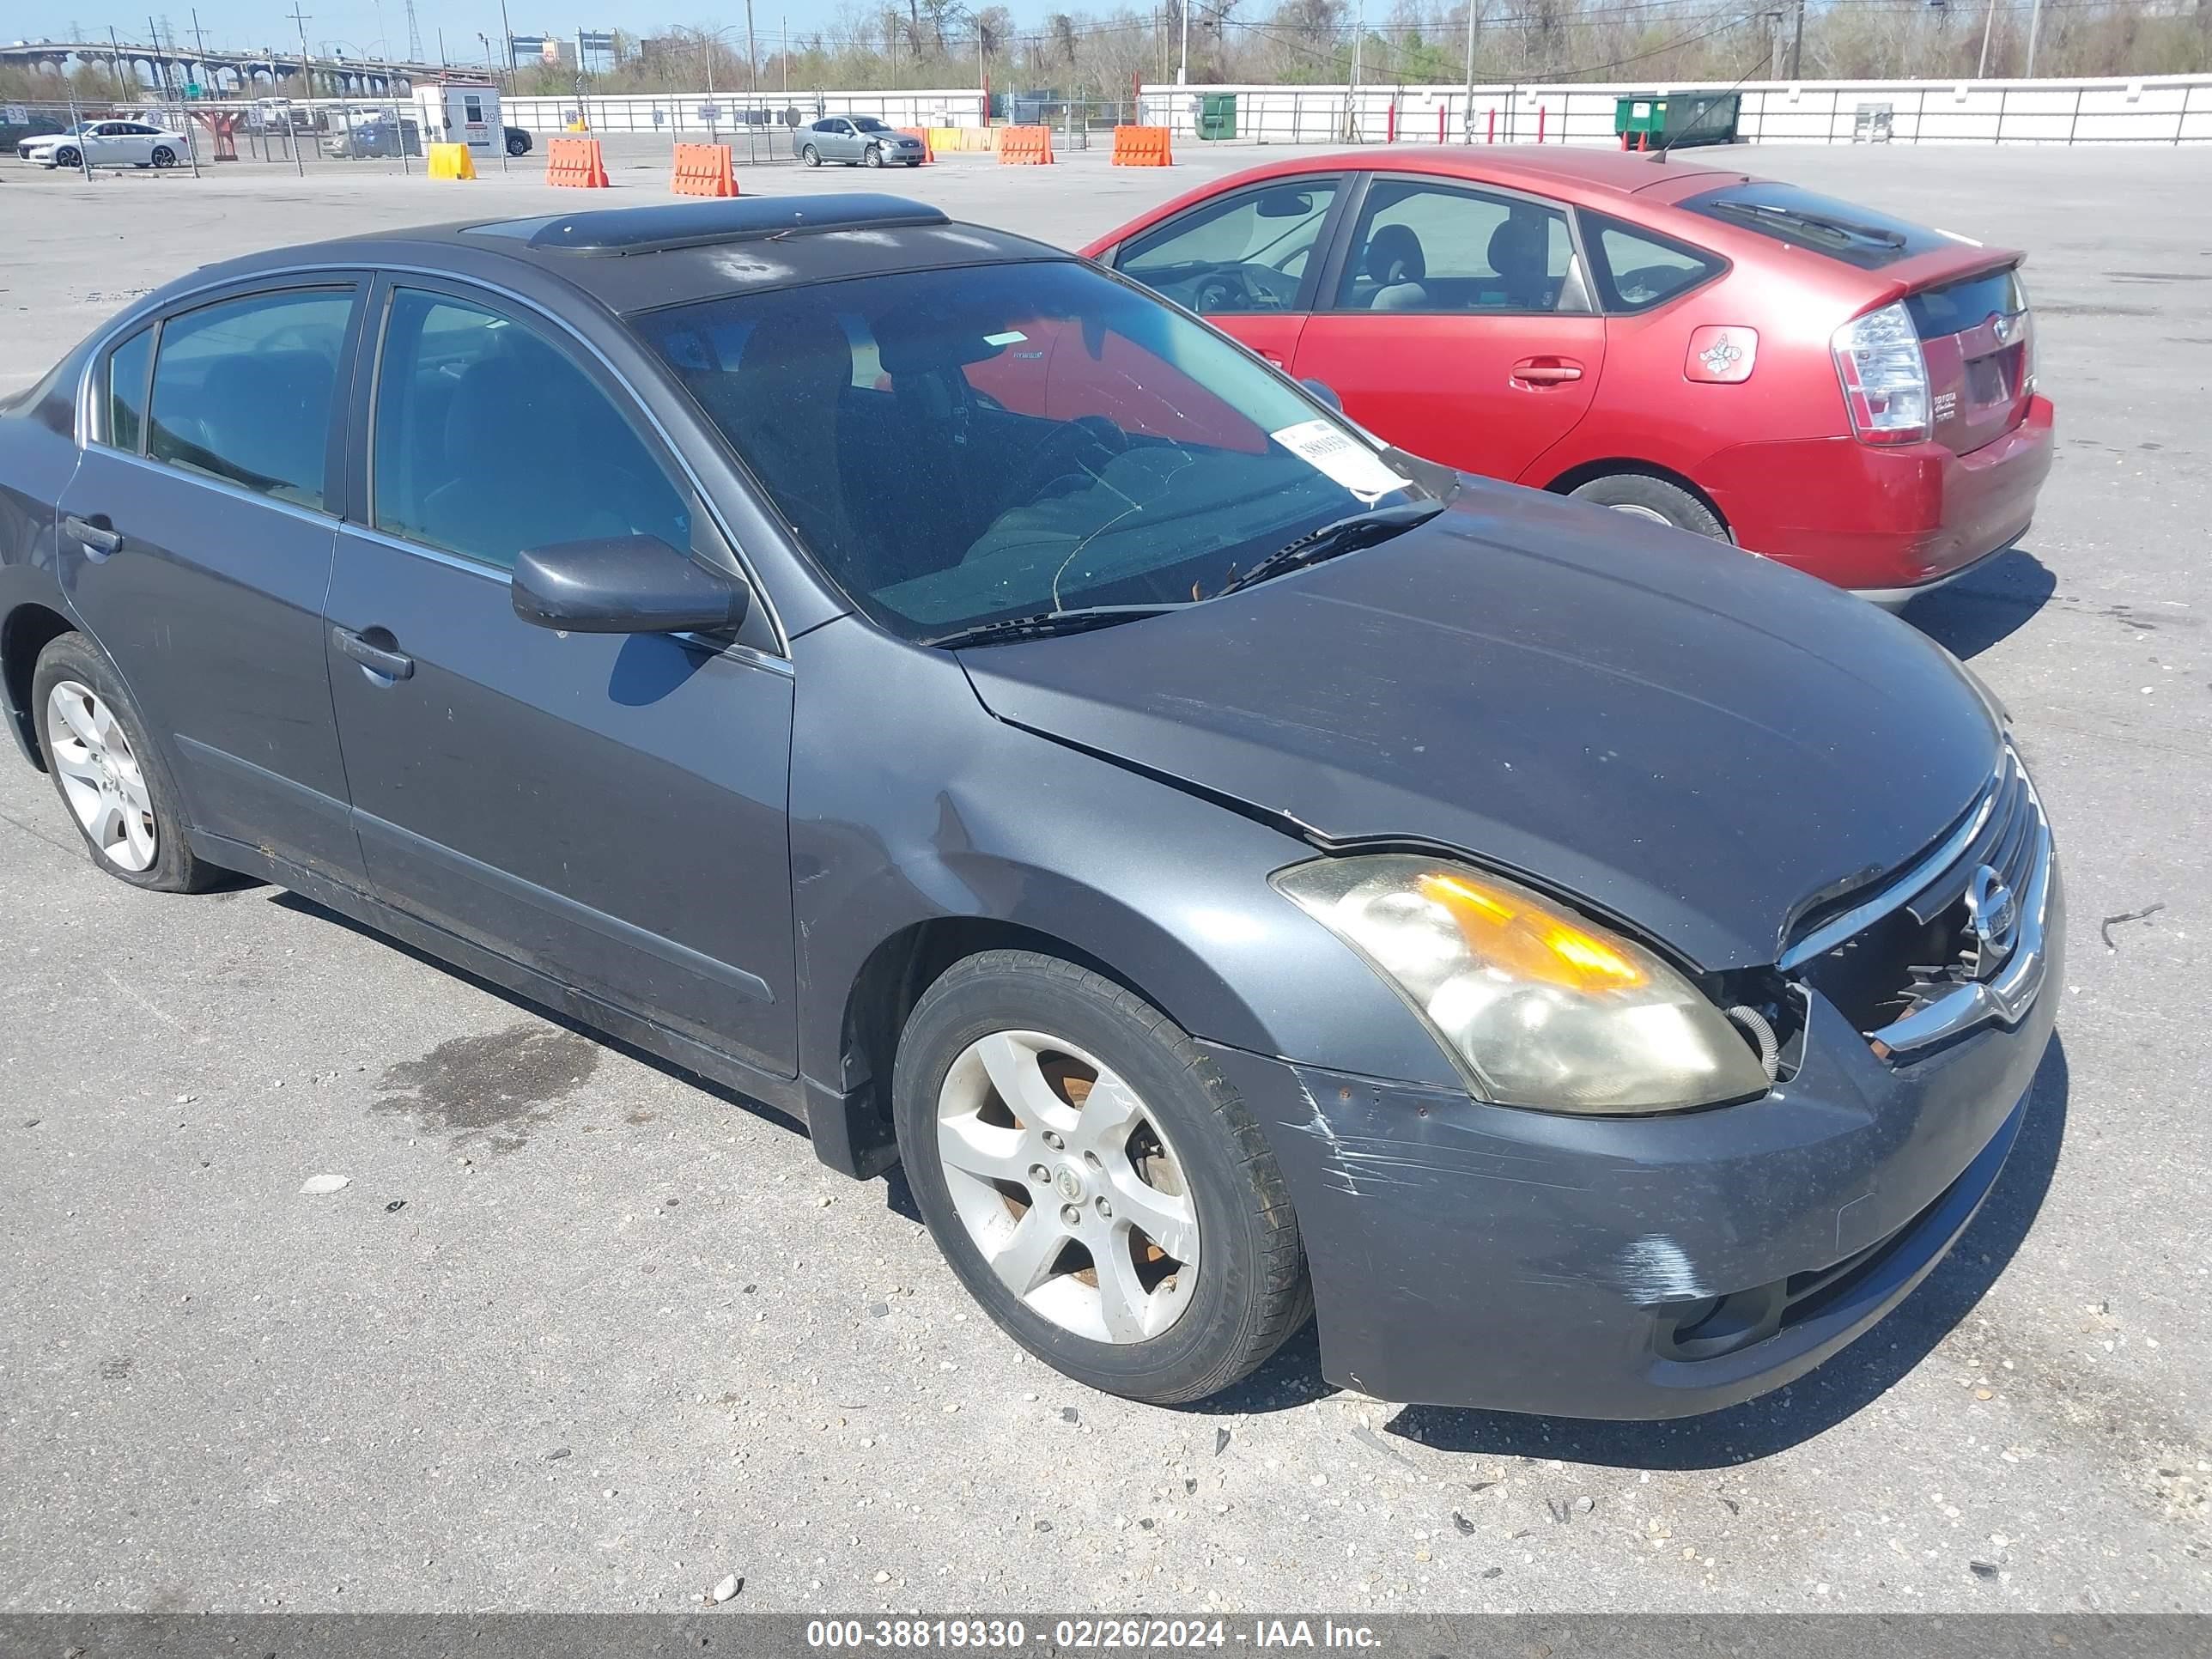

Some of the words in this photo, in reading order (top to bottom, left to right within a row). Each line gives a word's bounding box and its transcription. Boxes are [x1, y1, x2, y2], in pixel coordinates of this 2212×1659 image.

[9, 109, 26, 120] 33
[147, 112, 164, 124] 32
[251, 112, 264, 124] 31
[381, 110, 394, 121] 30
[483, 112, 495, 123] 29
[567, 112, 577, 122] 28
[653, 112, 663, 122] 27
[735, 111, 744, 121] 26
